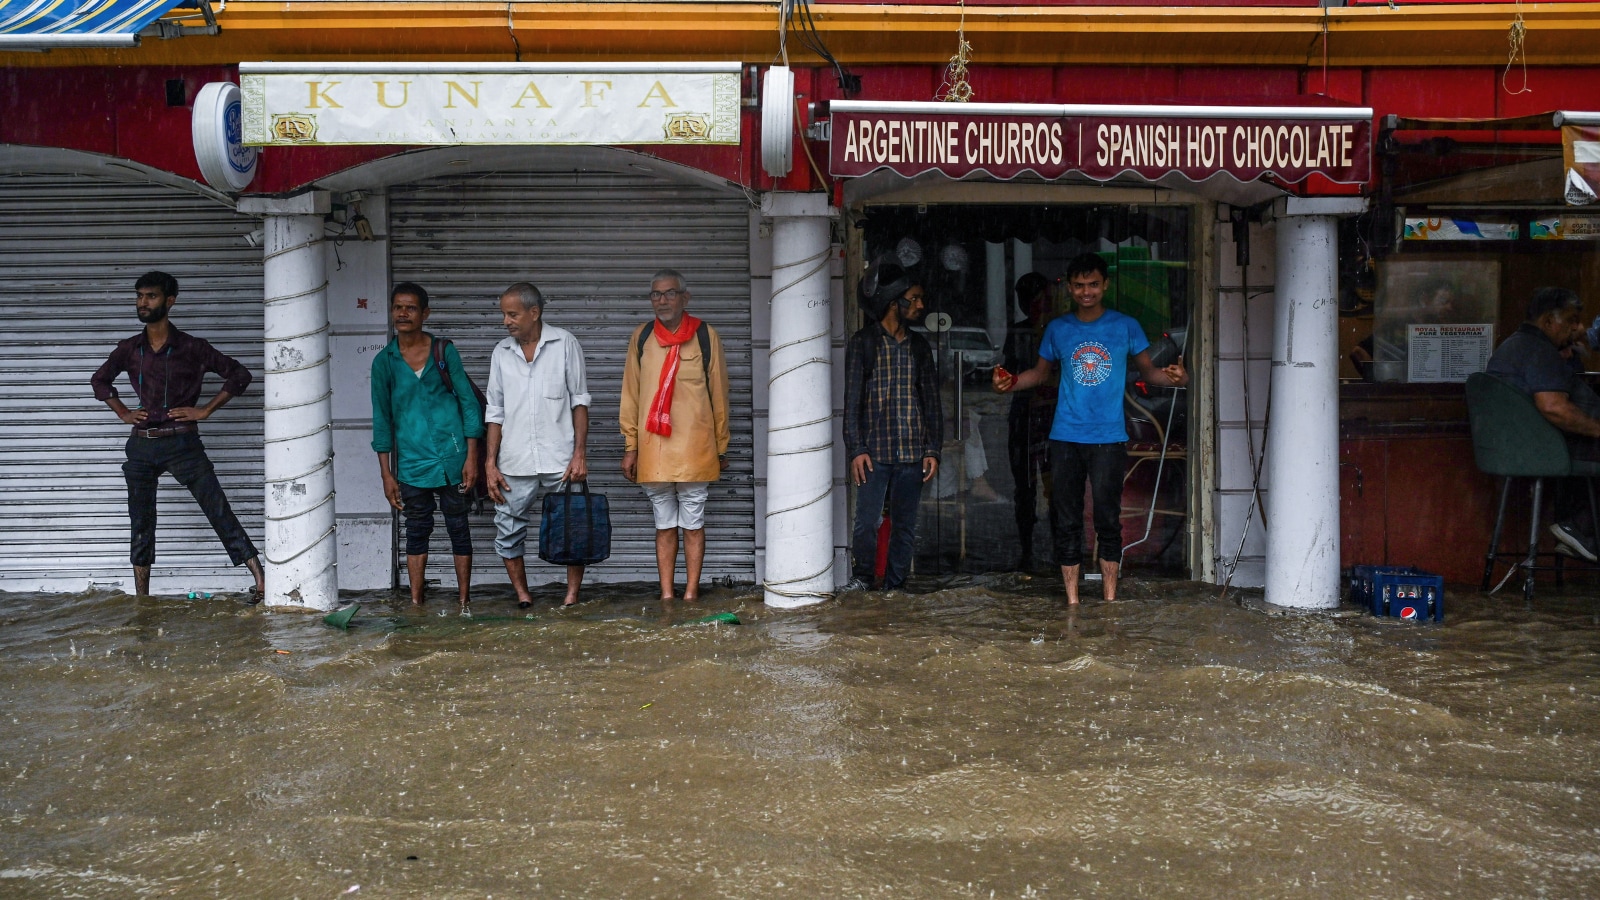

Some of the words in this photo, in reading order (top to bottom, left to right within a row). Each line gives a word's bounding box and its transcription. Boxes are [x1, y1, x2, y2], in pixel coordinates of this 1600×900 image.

[304, 80, 679, 109] KUNAFA
[422, 118, 558, 127] ANJANYA
[844, 119, 959, 164] ARGENTINE
[965, 121, 1063, 165] CHURROS
[1096, 123, 1180, 167] SPANISH
[1187, 125, 1228, 168] HOT
[1232, 125, 1353, 168] CHOCOLATE
